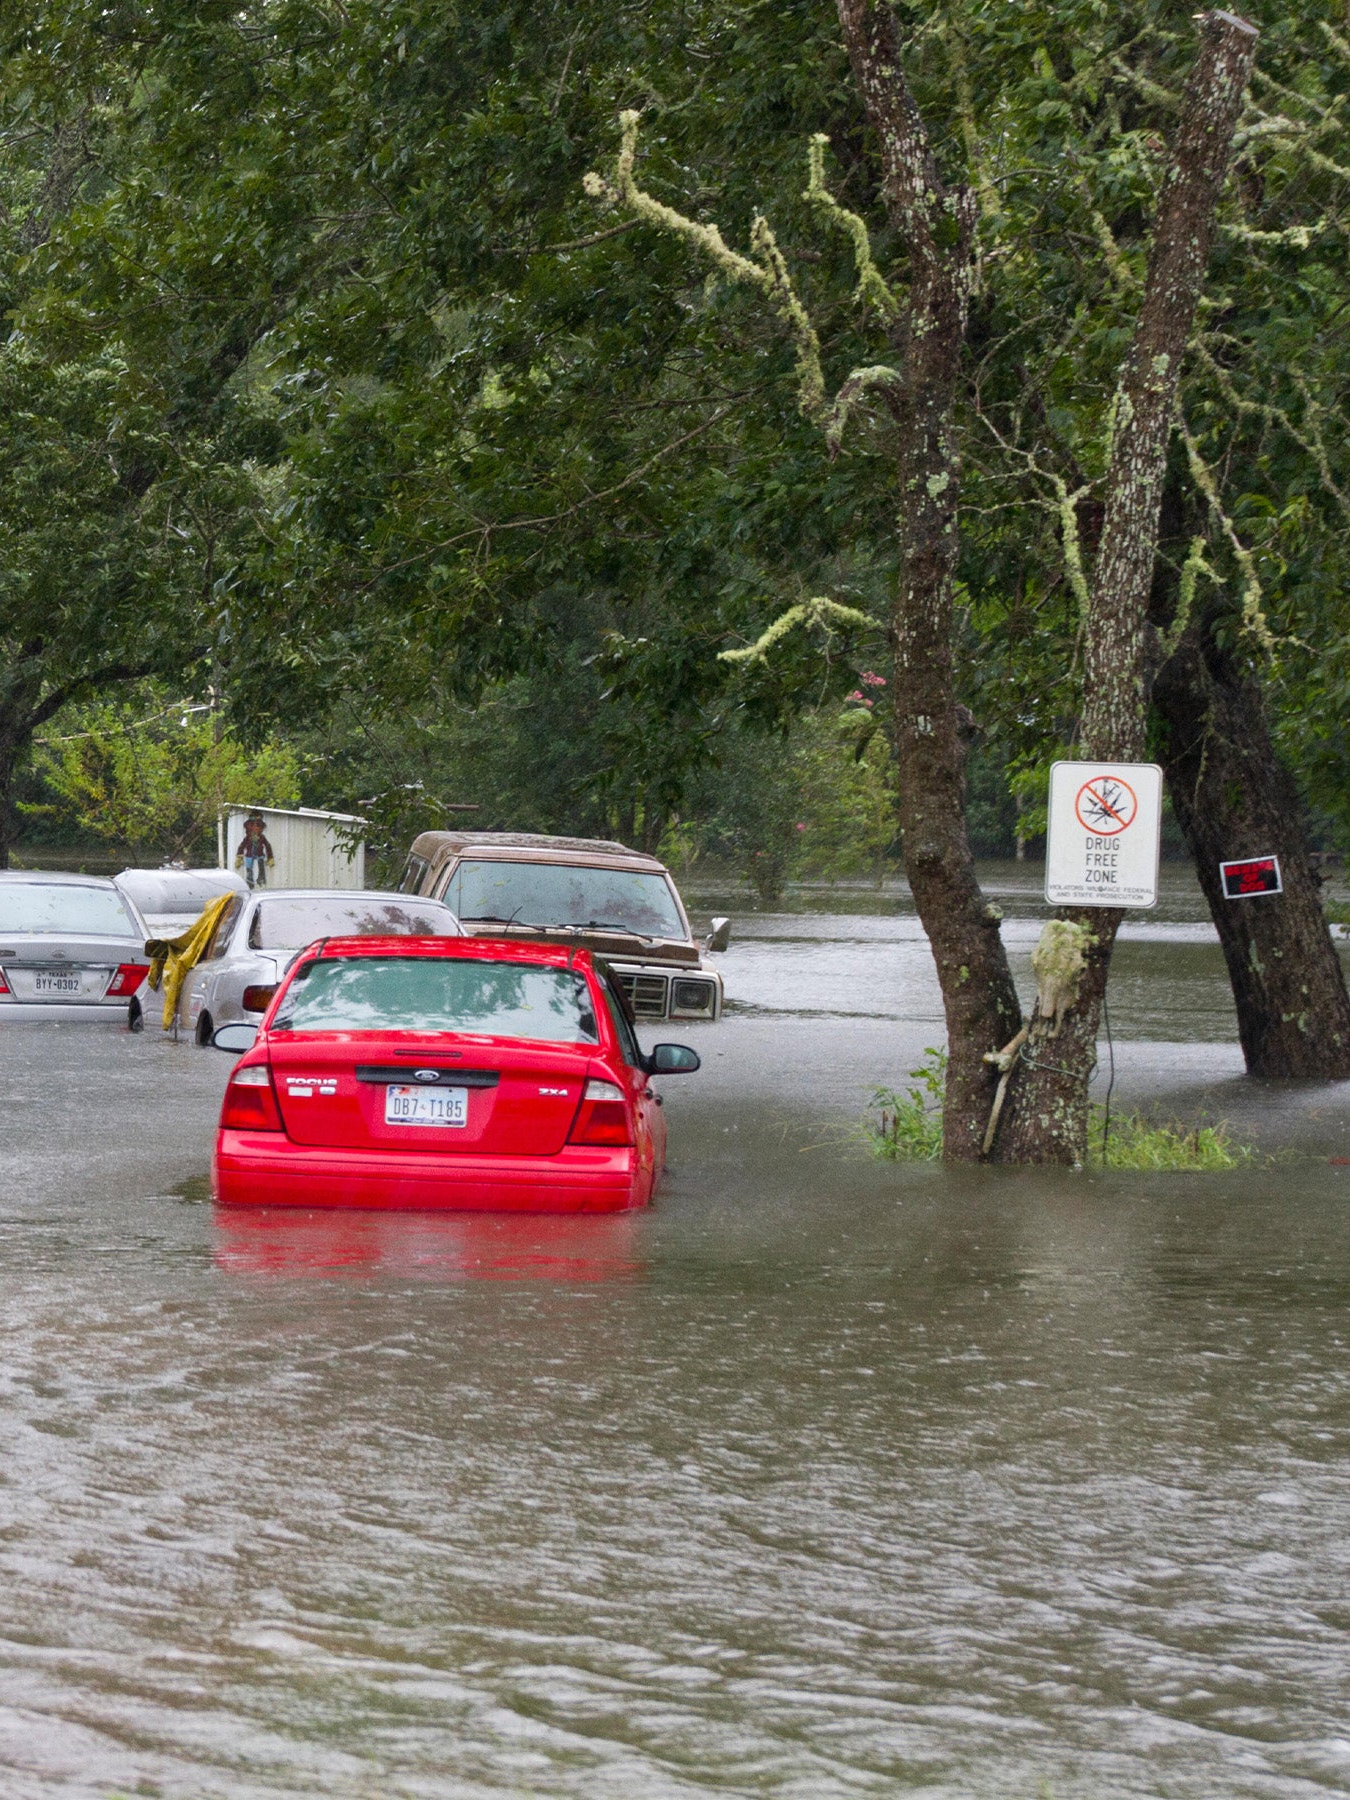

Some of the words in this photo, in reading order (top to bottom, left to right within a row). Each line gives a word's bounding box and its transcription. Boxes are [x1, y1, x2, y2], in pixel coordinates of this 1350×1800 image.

[1086, 837, 1120, 851] DRUG
[1086, 853, 1118, 867] FREE
[1225, 860, 1273, 876] BEWARE
[1085, 870, 1118, 884] ZONE
[1243, 872, 1258, 883] OF
[1123, 887, 1153, 895] FEDERAL
[1239, 881, 1265, 893] DOG
[1096, 893, 1144, 901] PROSECUTION
[286, 1077, 338, 1085] FOCUS
[538, 1087, 568, 1096] ZX4
